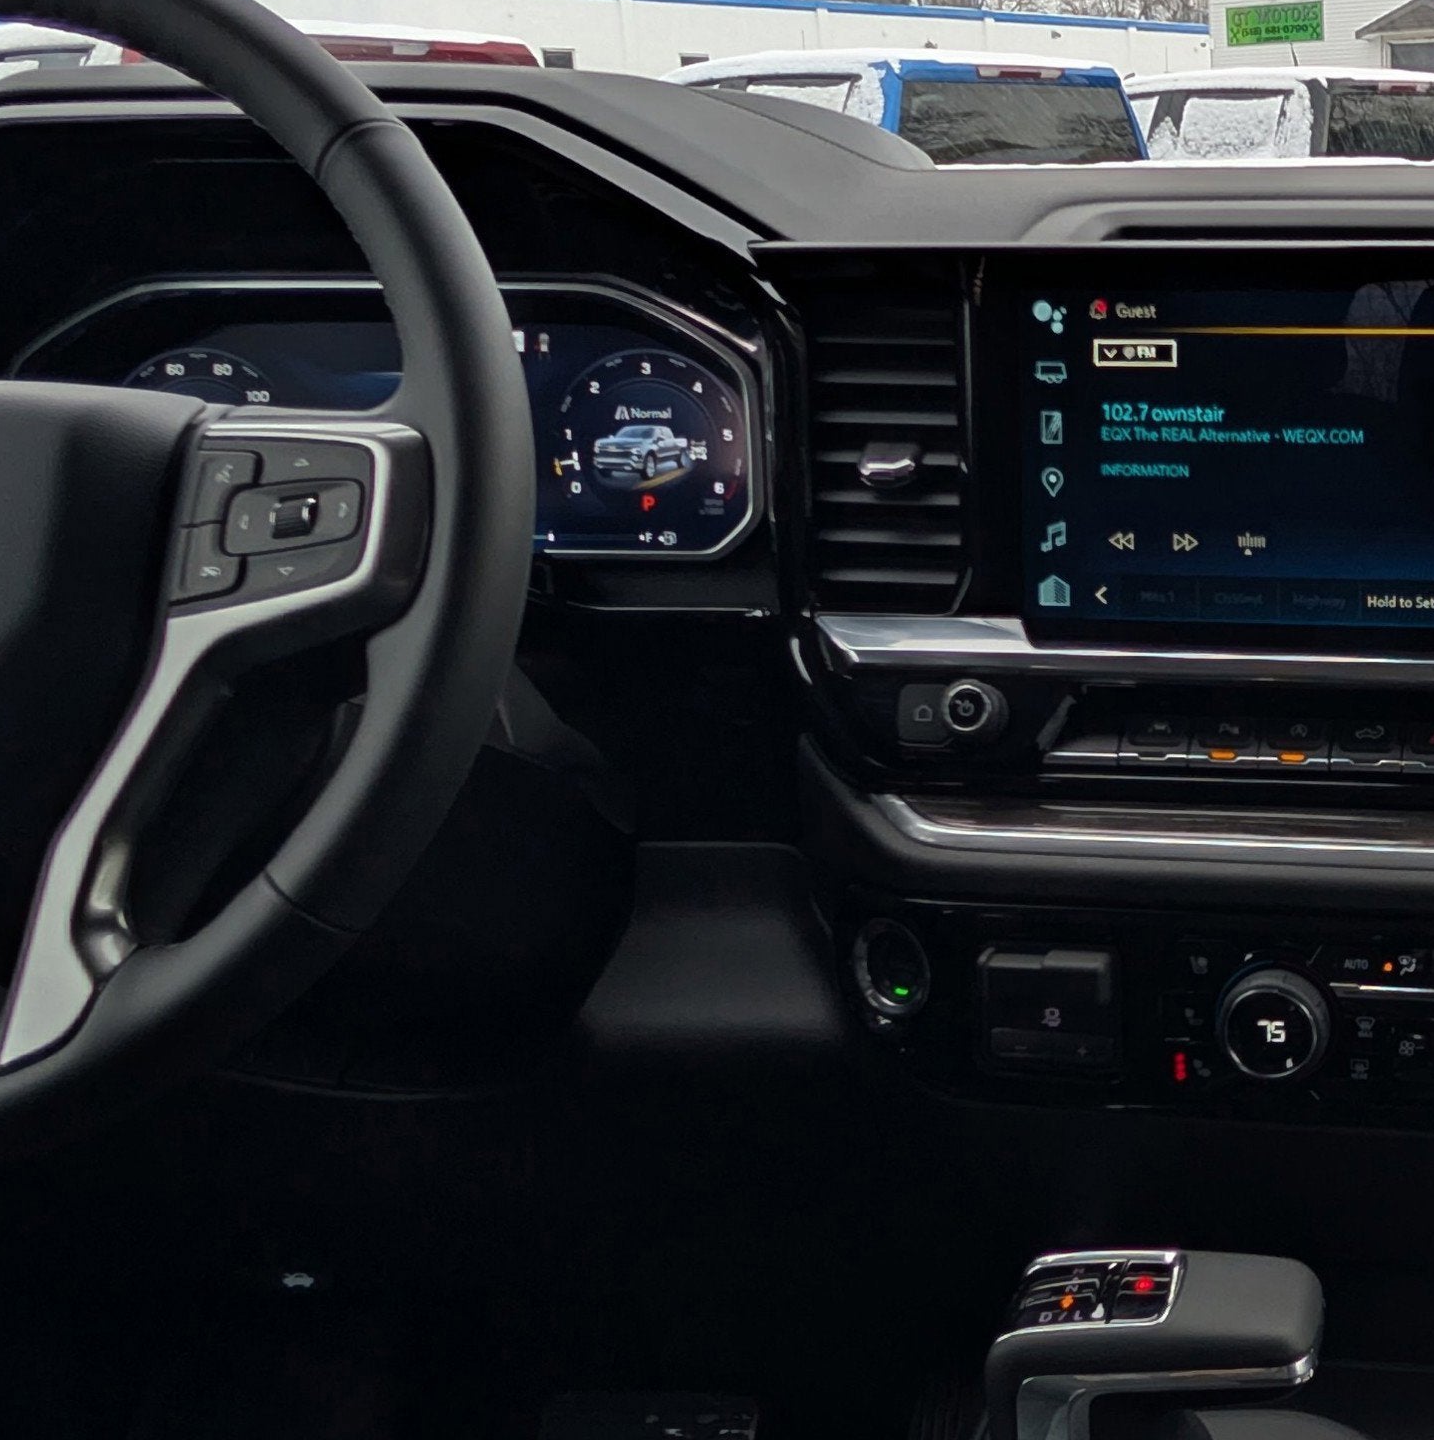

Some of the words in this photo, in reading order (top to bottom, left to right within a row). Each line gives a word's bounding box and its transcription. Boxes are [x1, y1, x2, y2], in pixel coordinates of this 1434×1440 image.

[1256, 3, 1319, 25] MOTORS
[1116, 303, 1157, 319] Guest
[640, 362, 651, 375] 3
[589, 380, 600, 394] 2
[693, 380, 703, 393] 4
[245, 390, 270, 403] 100
[630, 407, 673, 420] Normal
[1102, 404, 1149, 422] 102.7
[1151, 406, 1225, 422] ownstair
[565, 428, 573, 441] 1
[723, 429, 734, 442] 5
[1101, 426, 1131, 442] EQX
[1133, 426, 1159, 442] The
[1161, 427, 1197, 443] REAL
[1199, 427, 1271, 443] Alternative
[1282, 428, 1364, 444] WEQX.COM
[1101, 463, 1190, 478] INFORMATION
[570, 480, 582, 494] 0
[713, 481, 725, 494] 6
[642, 495, 655, 511] P
[1367, 595, 1397, 609] Hold
[1399, 597, 1413, 609] to
[1344, 957, 1369, 970] AUTO
[1257, 1019, 1286, 1043] 75
[1038, 1311, 1053, 1323] D
[1073, 1310, 1084, 1321] L
